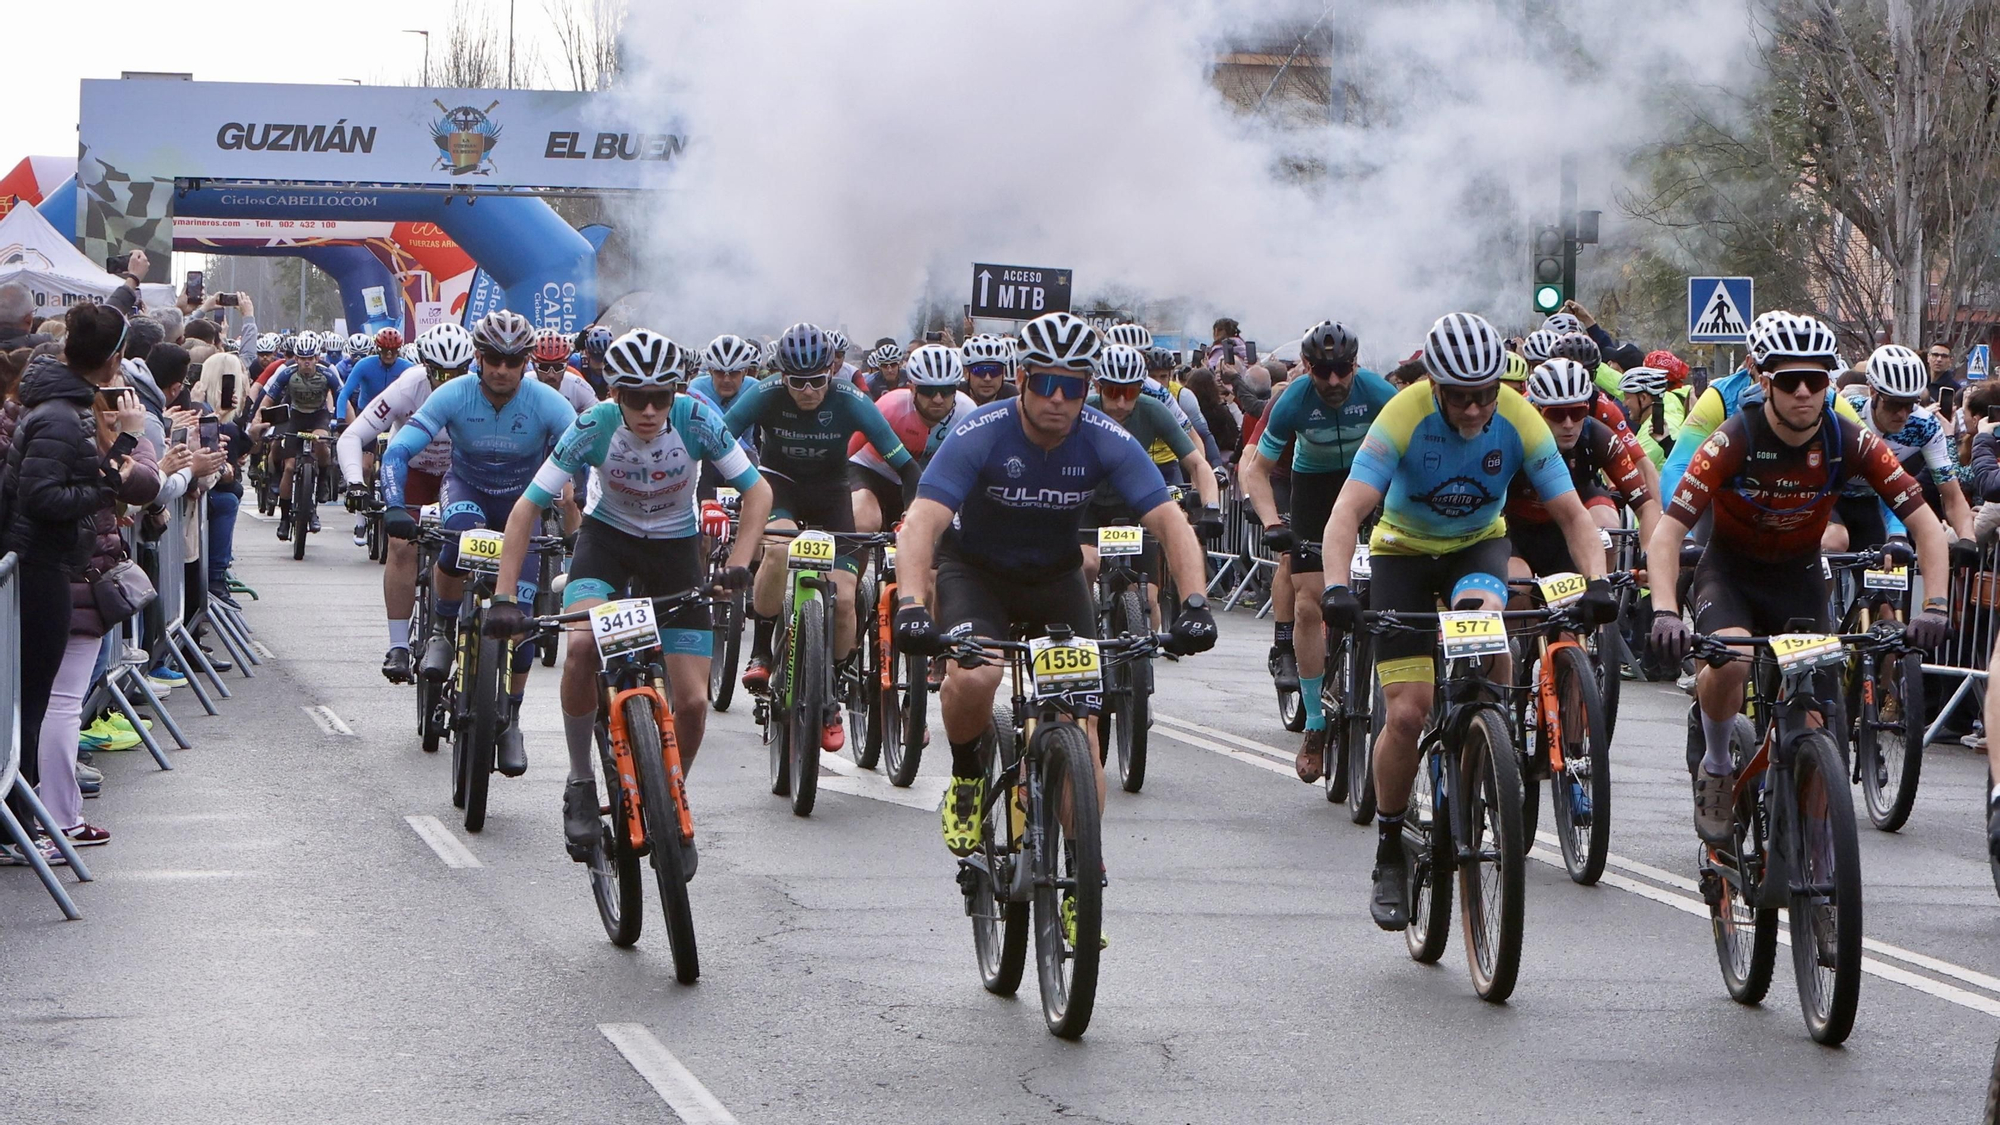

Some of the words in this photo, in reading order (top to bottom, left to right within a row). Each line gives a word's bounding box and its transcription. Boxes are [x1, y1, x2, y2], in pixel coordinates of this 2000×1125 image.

[216, 118, 378, 154] GUZMÁN
[544, 131, 588, 160] EL
[592, 132, 698, 162] BUEN
[256, 220, 274, 228] Telf.
[279, 220, 295, 228] 902
[299, 221, 315, 229] 432
[321, 221, 336, 229] 100
[409, 239, 440, 248] FUERZAS
[1003, 269, 1042, 283] ACCESO
[998, 284, 1045, 311] MTB
[955, 407, 1010, 437] CULMAR
[1080, 410, 1132, 441] CULMAR
[1756, 450, 1778, 460] GOBIK
[986, 485, 1096, 505] CULMAR
[1103, 530, 1136, 540] 2041
[470, 539, 497, 555] 360
[795, 541, 830, 556] 1937
[1548, 576, 1585, 597] 1827
[600, 609, 648, 633] 3413
[900, 620, 930, 630] FOX
[1181, 620, 1213, 631] FOX
[1456, 620, 1491, 634] 577
[1040, 648, 1092, 671] 1558
